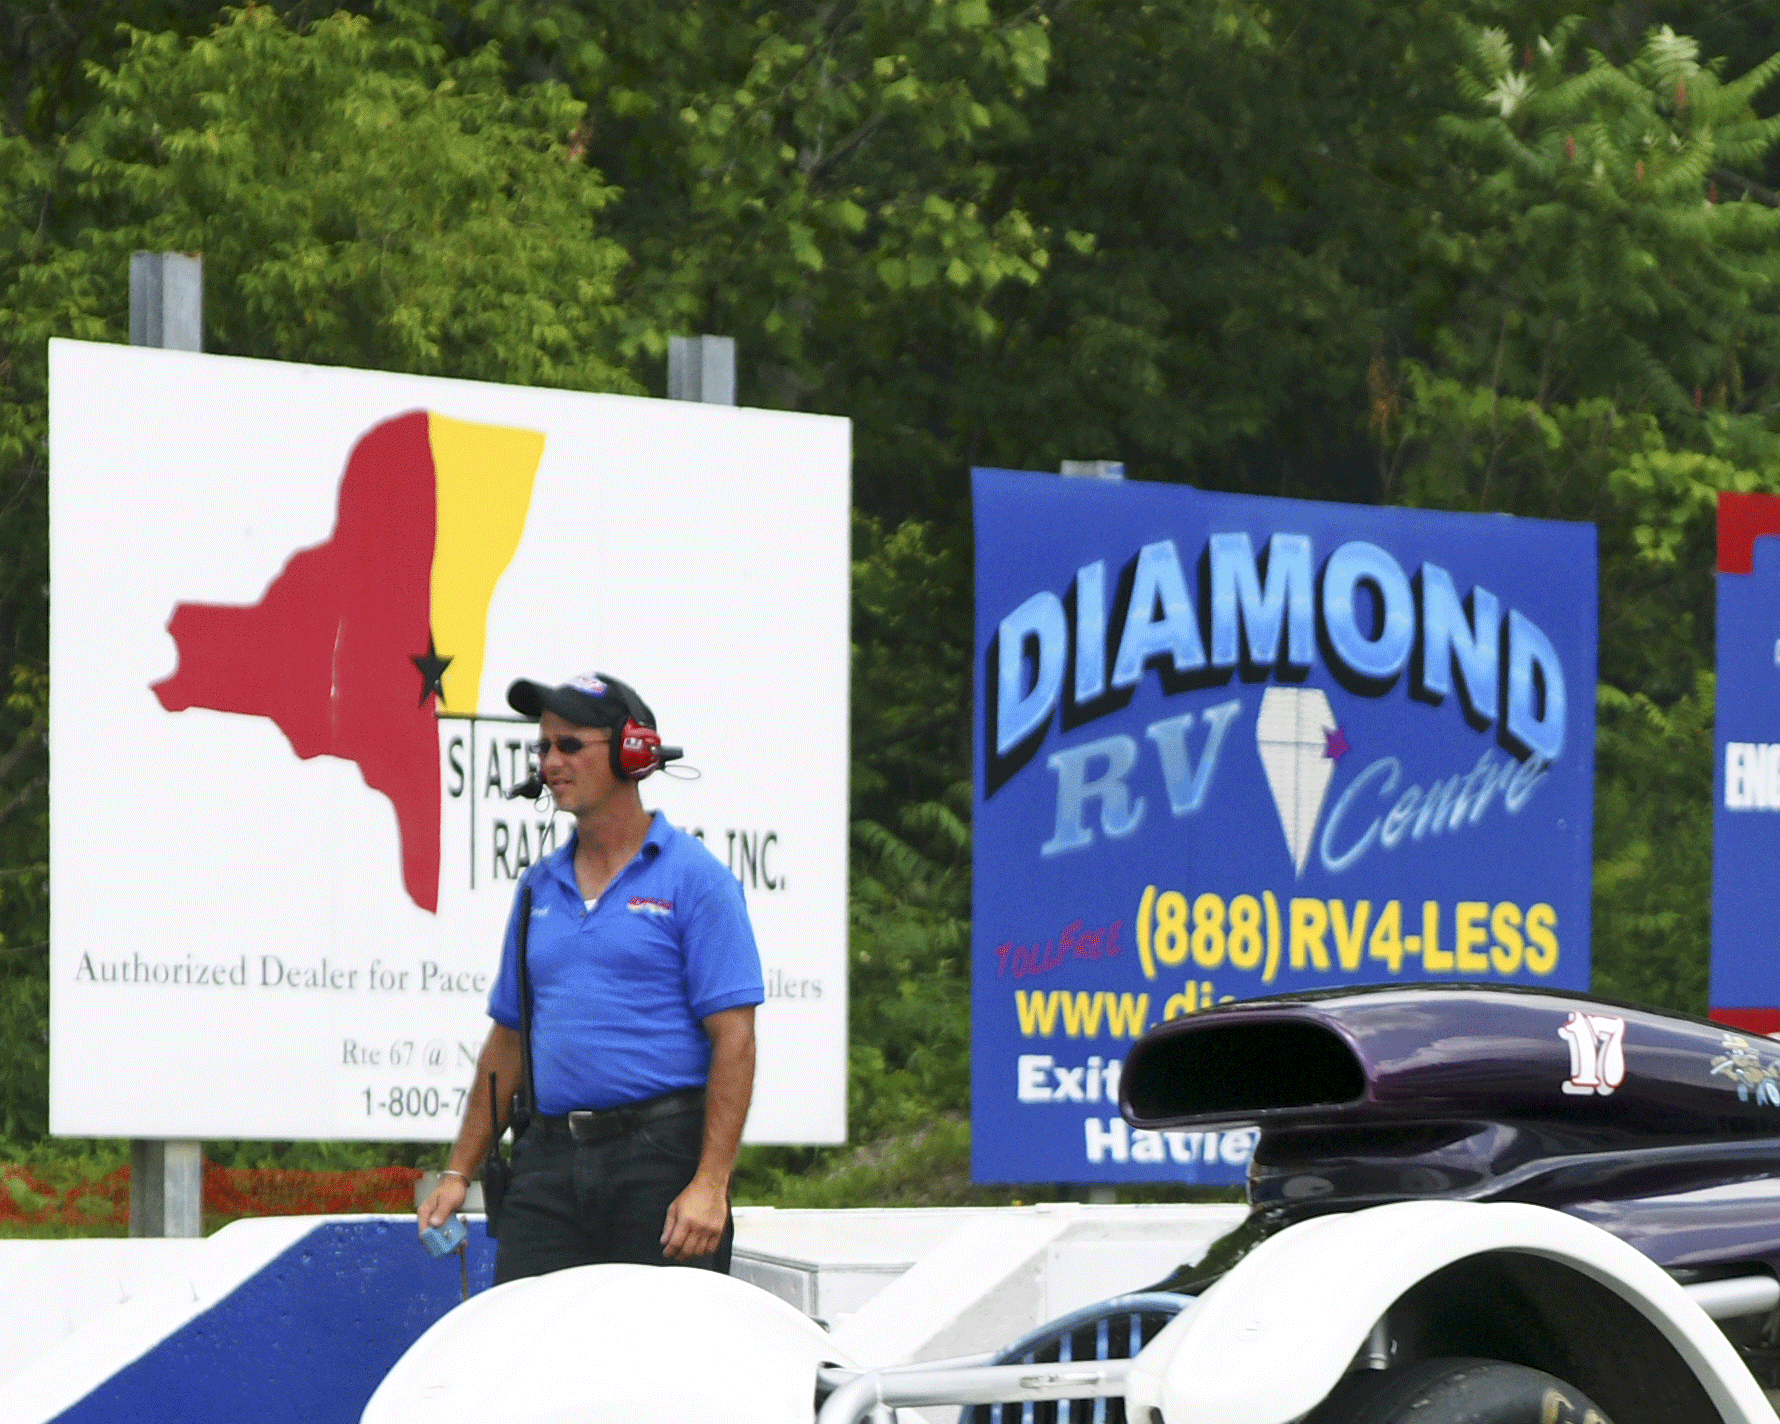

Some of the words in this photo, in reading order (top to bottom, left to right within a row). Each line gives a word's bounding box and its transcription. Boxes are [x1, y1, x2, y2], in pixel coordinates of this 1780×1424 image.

[985, 532, 1567, 798] DIAMOND
[1040, 700, 1241, 857] RV
[1320, 747, 1548, 872] Centre
[727, 830, 786, 891] INC.
[75, 950, 248, 987] Authorized
[259, 955, 358, 990] Dealer
[370, 960, 410, 990] for
[420, 961, 487, 993] Pace
[766, 968, 823, 998] ilers
[342, 1039, 381, 1066] Rte
[389, 1040, 415, 1067] 67
[1557, 1011, 1625, 1095] 17
